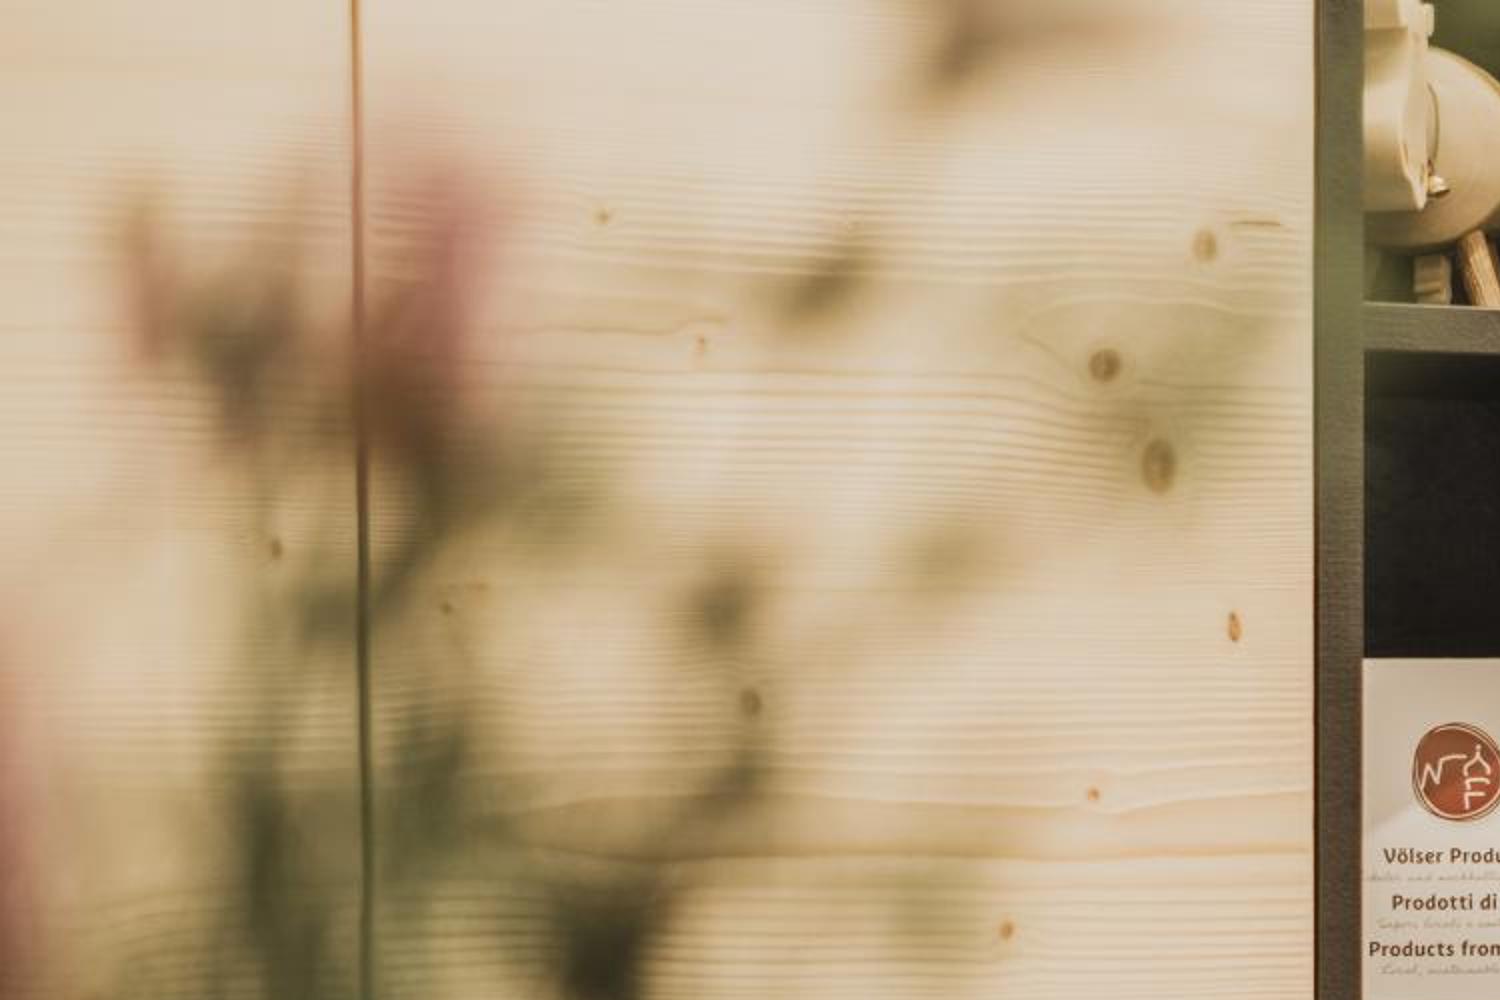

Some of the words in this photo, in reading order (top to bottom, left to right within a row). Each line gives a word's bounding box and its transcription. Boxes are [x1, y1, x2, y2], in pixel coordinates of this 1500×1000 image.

[1383, 847, 1444, 865] Völser
[1392, 894, 1474, 911] Prodotti
[1480, 894, 1498, 911] di
[1369, 941, 1455, 957] Products
